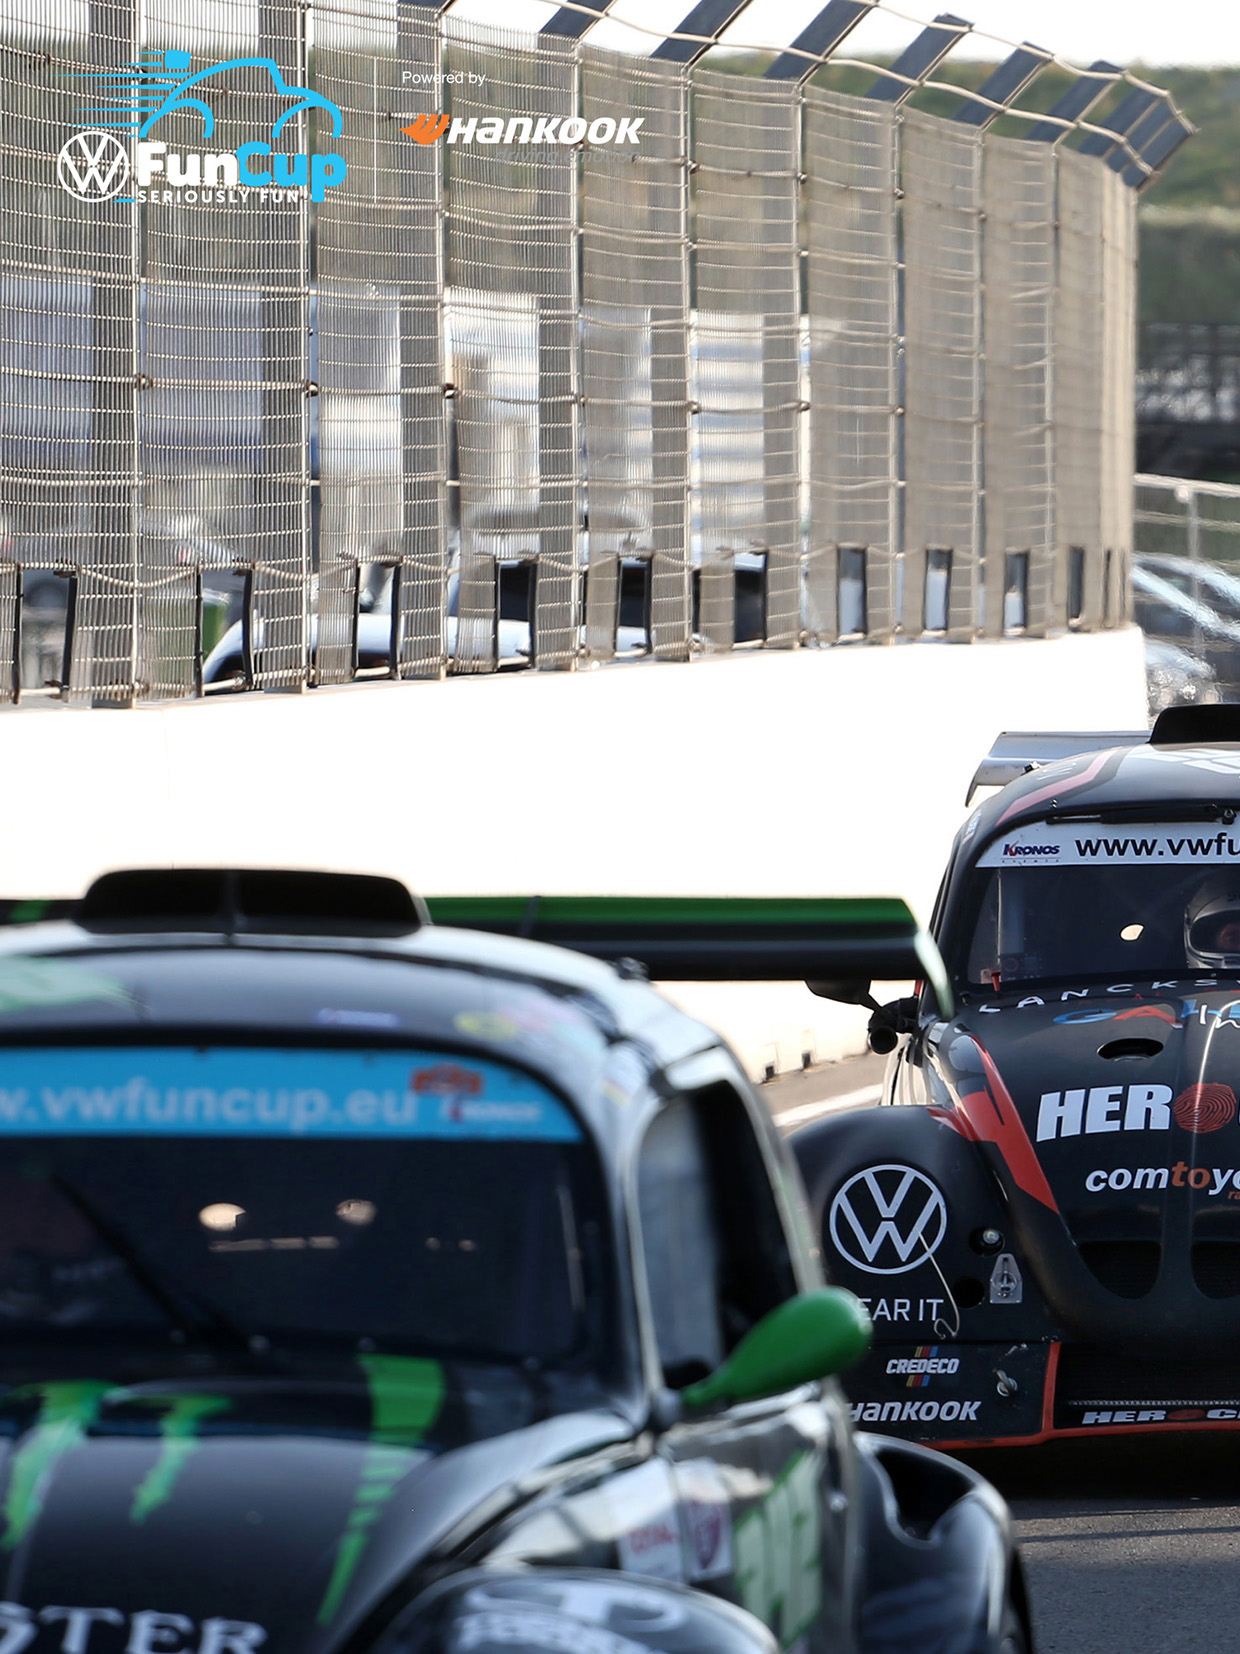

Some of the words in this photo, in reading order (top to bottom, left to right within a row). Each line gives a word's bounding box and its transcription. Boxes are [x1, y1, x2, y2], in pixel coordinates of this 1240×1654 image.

[1003, 840, 1060, 856] KRONOS
[857, 1298, 910, 1321] EAR
[919, 1299, 944, 1321] IT
[886, 1358, 959, 1374] CREDECO
